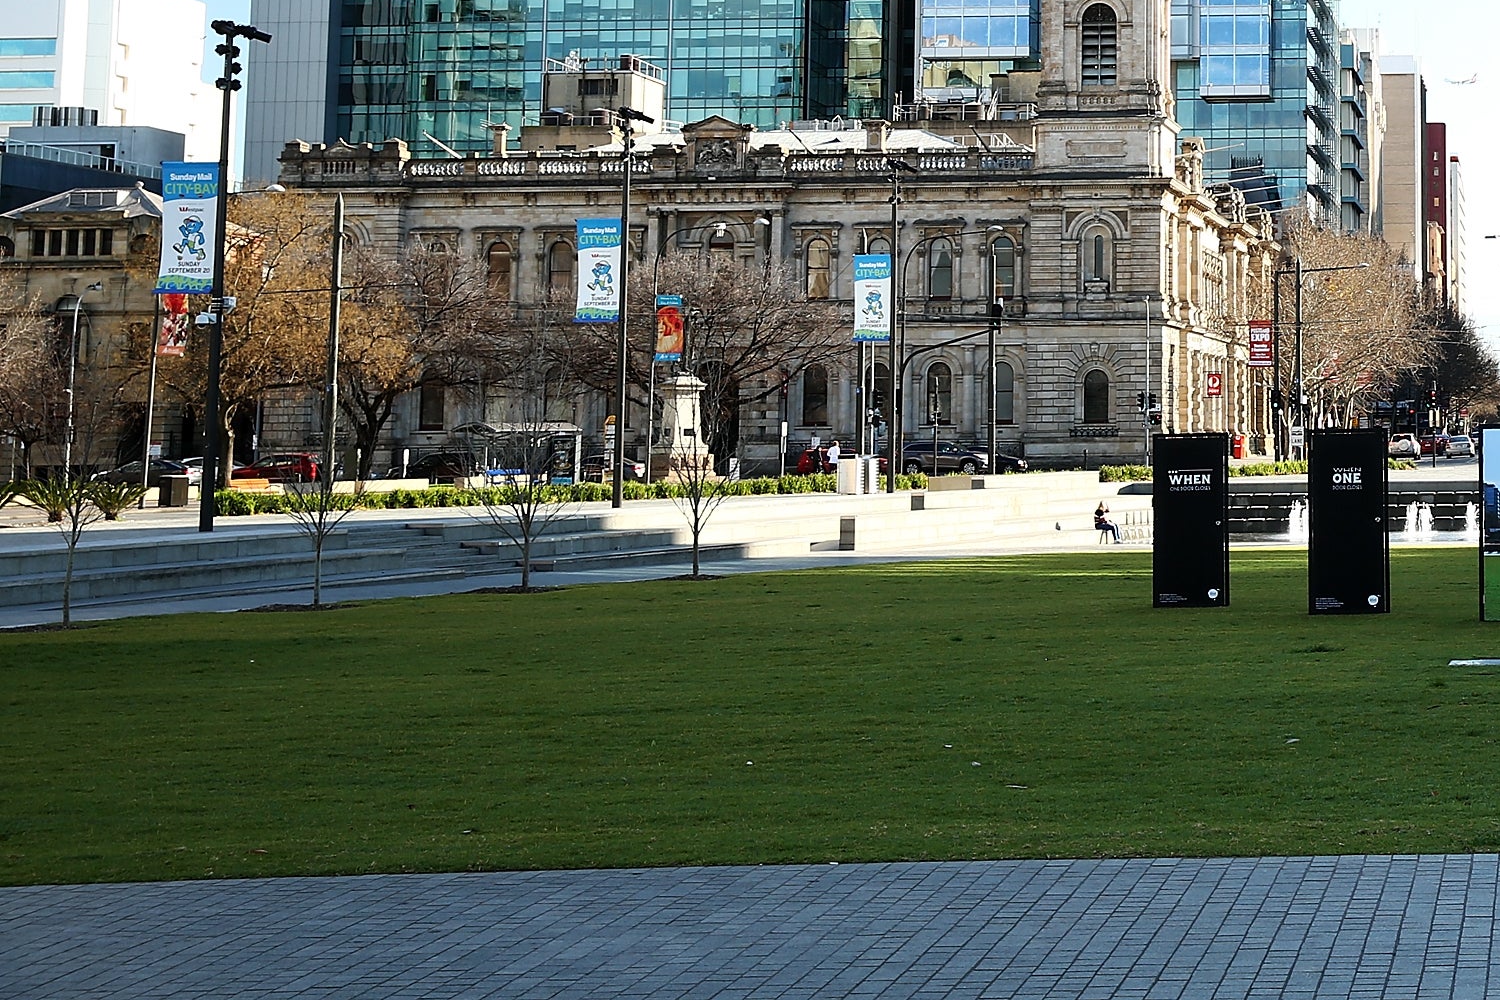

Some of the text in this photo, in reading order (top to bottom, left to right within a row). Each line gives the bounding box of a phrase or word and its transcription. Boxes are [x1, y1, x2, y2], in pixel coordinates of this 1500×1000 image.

[170, 173, 198, 182] Sunday
[164, 183, 218, 194] CITY-BAY
[579, 235, 621, 244] CITY-BAY
[855, 268, 891, 277] CITY-BAY
[1250, 333, 1270, 342] EXPO
[1168, 474, 1211, 485] WHEN
[1332, 473, 1362, 483] ONE
